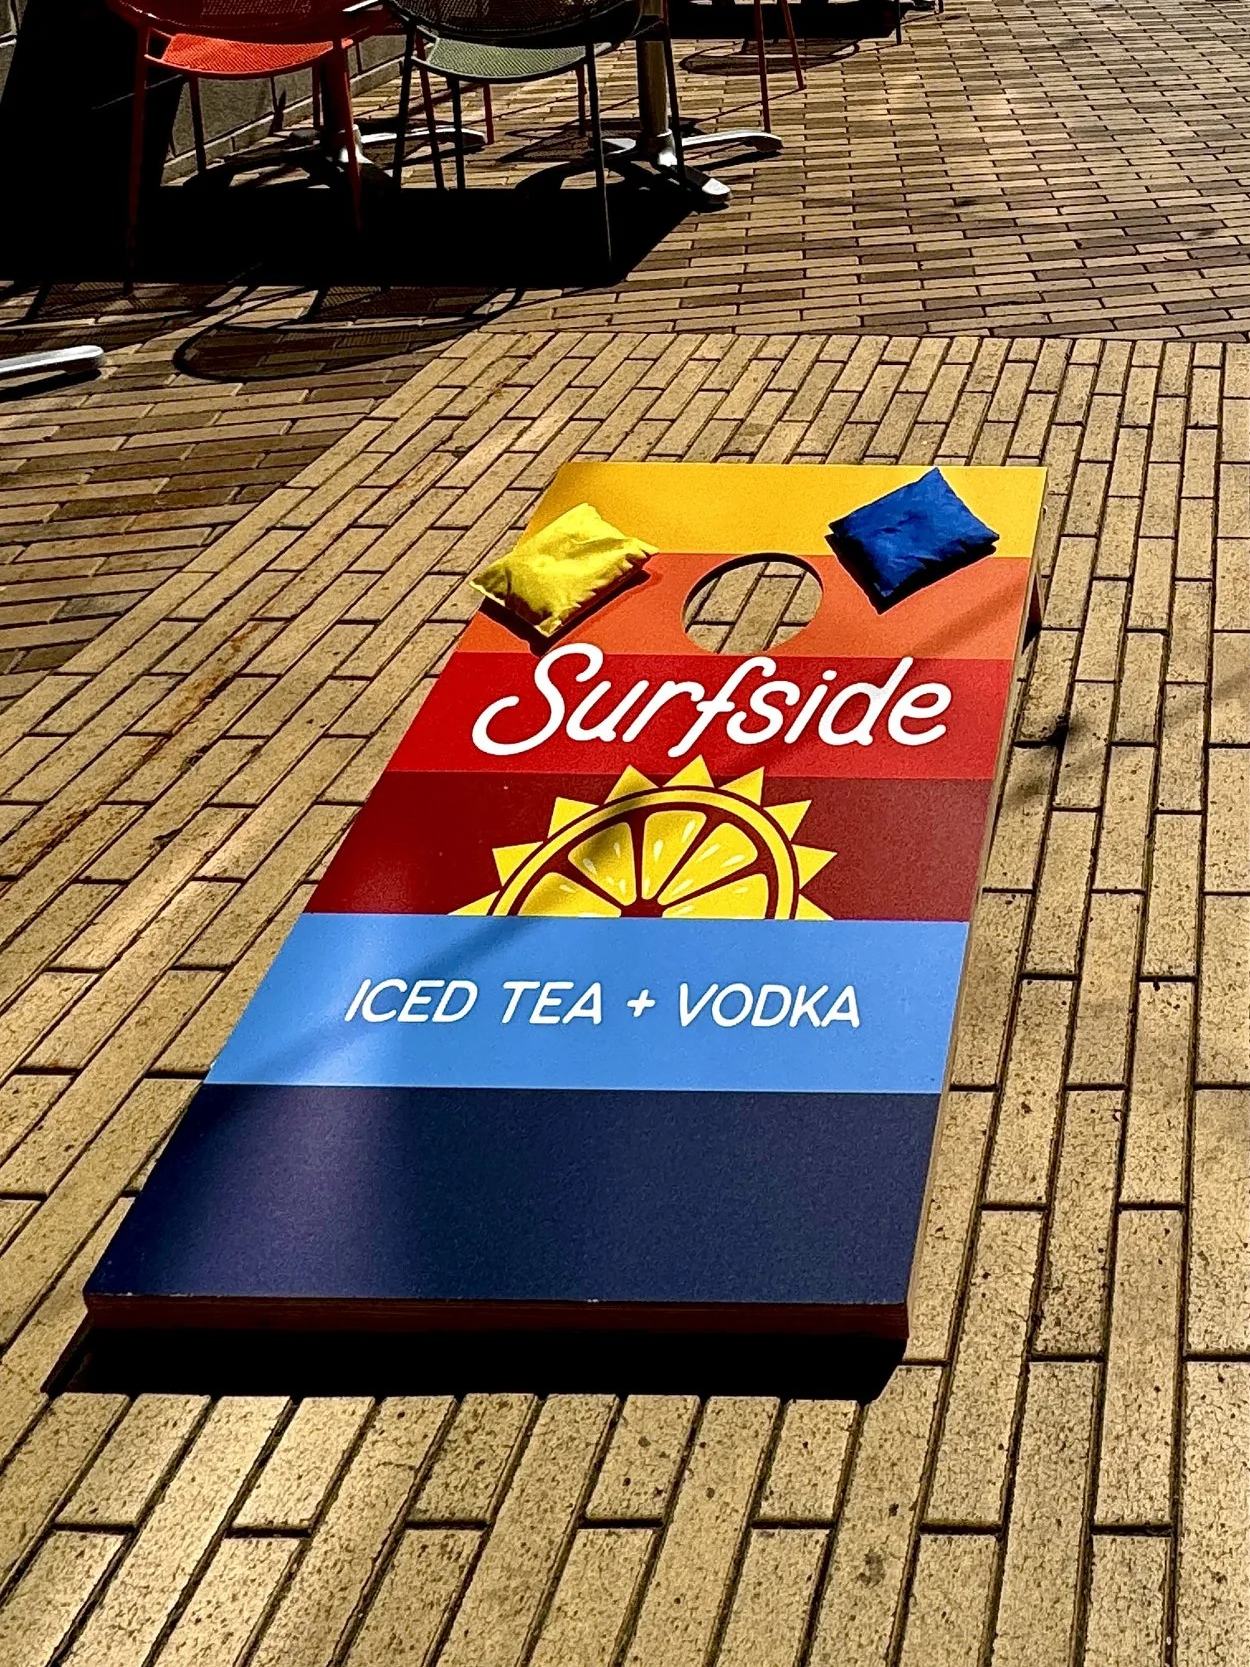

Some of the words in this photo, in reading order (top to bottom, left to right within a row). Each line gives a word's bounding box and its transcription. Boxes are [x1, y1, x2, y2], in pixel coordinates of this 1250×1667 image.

[471, 642, 952, 758] Surfside
[343, 978, 479, 1023] ICED
[501, 980, 603, 1025] TEA
[626, 988, 656, 1018] +
[678, 982, 861, 1029] VODKA
